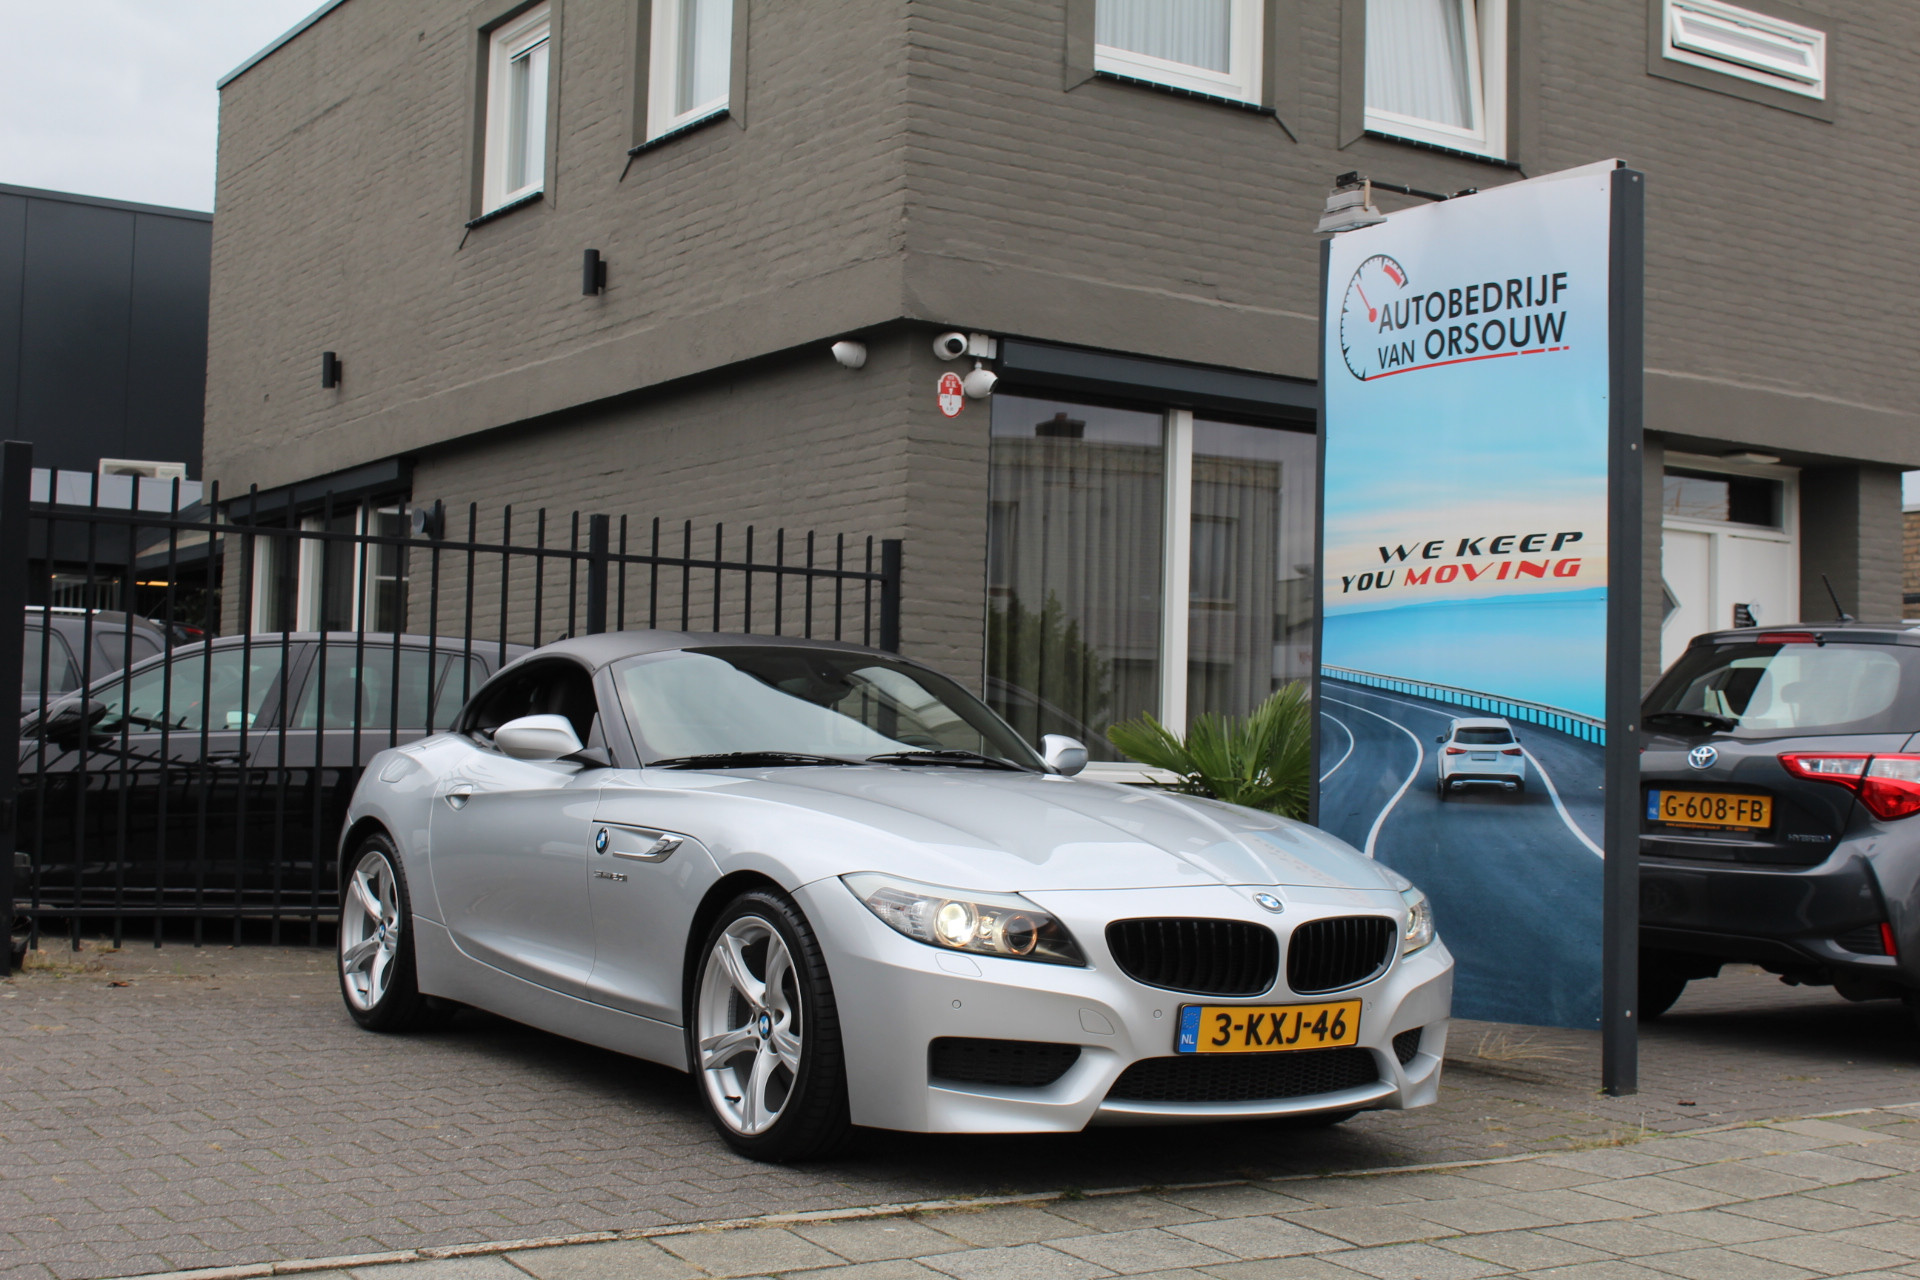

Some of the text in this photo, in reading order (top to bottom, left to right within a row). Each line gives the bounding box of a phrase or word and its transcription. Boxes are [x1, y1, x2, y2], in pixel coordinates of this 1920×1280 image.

[1379, 272, 1568, 334] AUTOBEDRIJF
[1378, 311, 1567, 369] VAN ORSOUW
[1379, 531, 1584, 564] WE KEEP
[1341, 558, 1582, 593] YOU MOVING
[1665, 795, 1763, 822] G-608-FB
[1181, 1008, 1347, 1046] NL 3-KXJ-46
